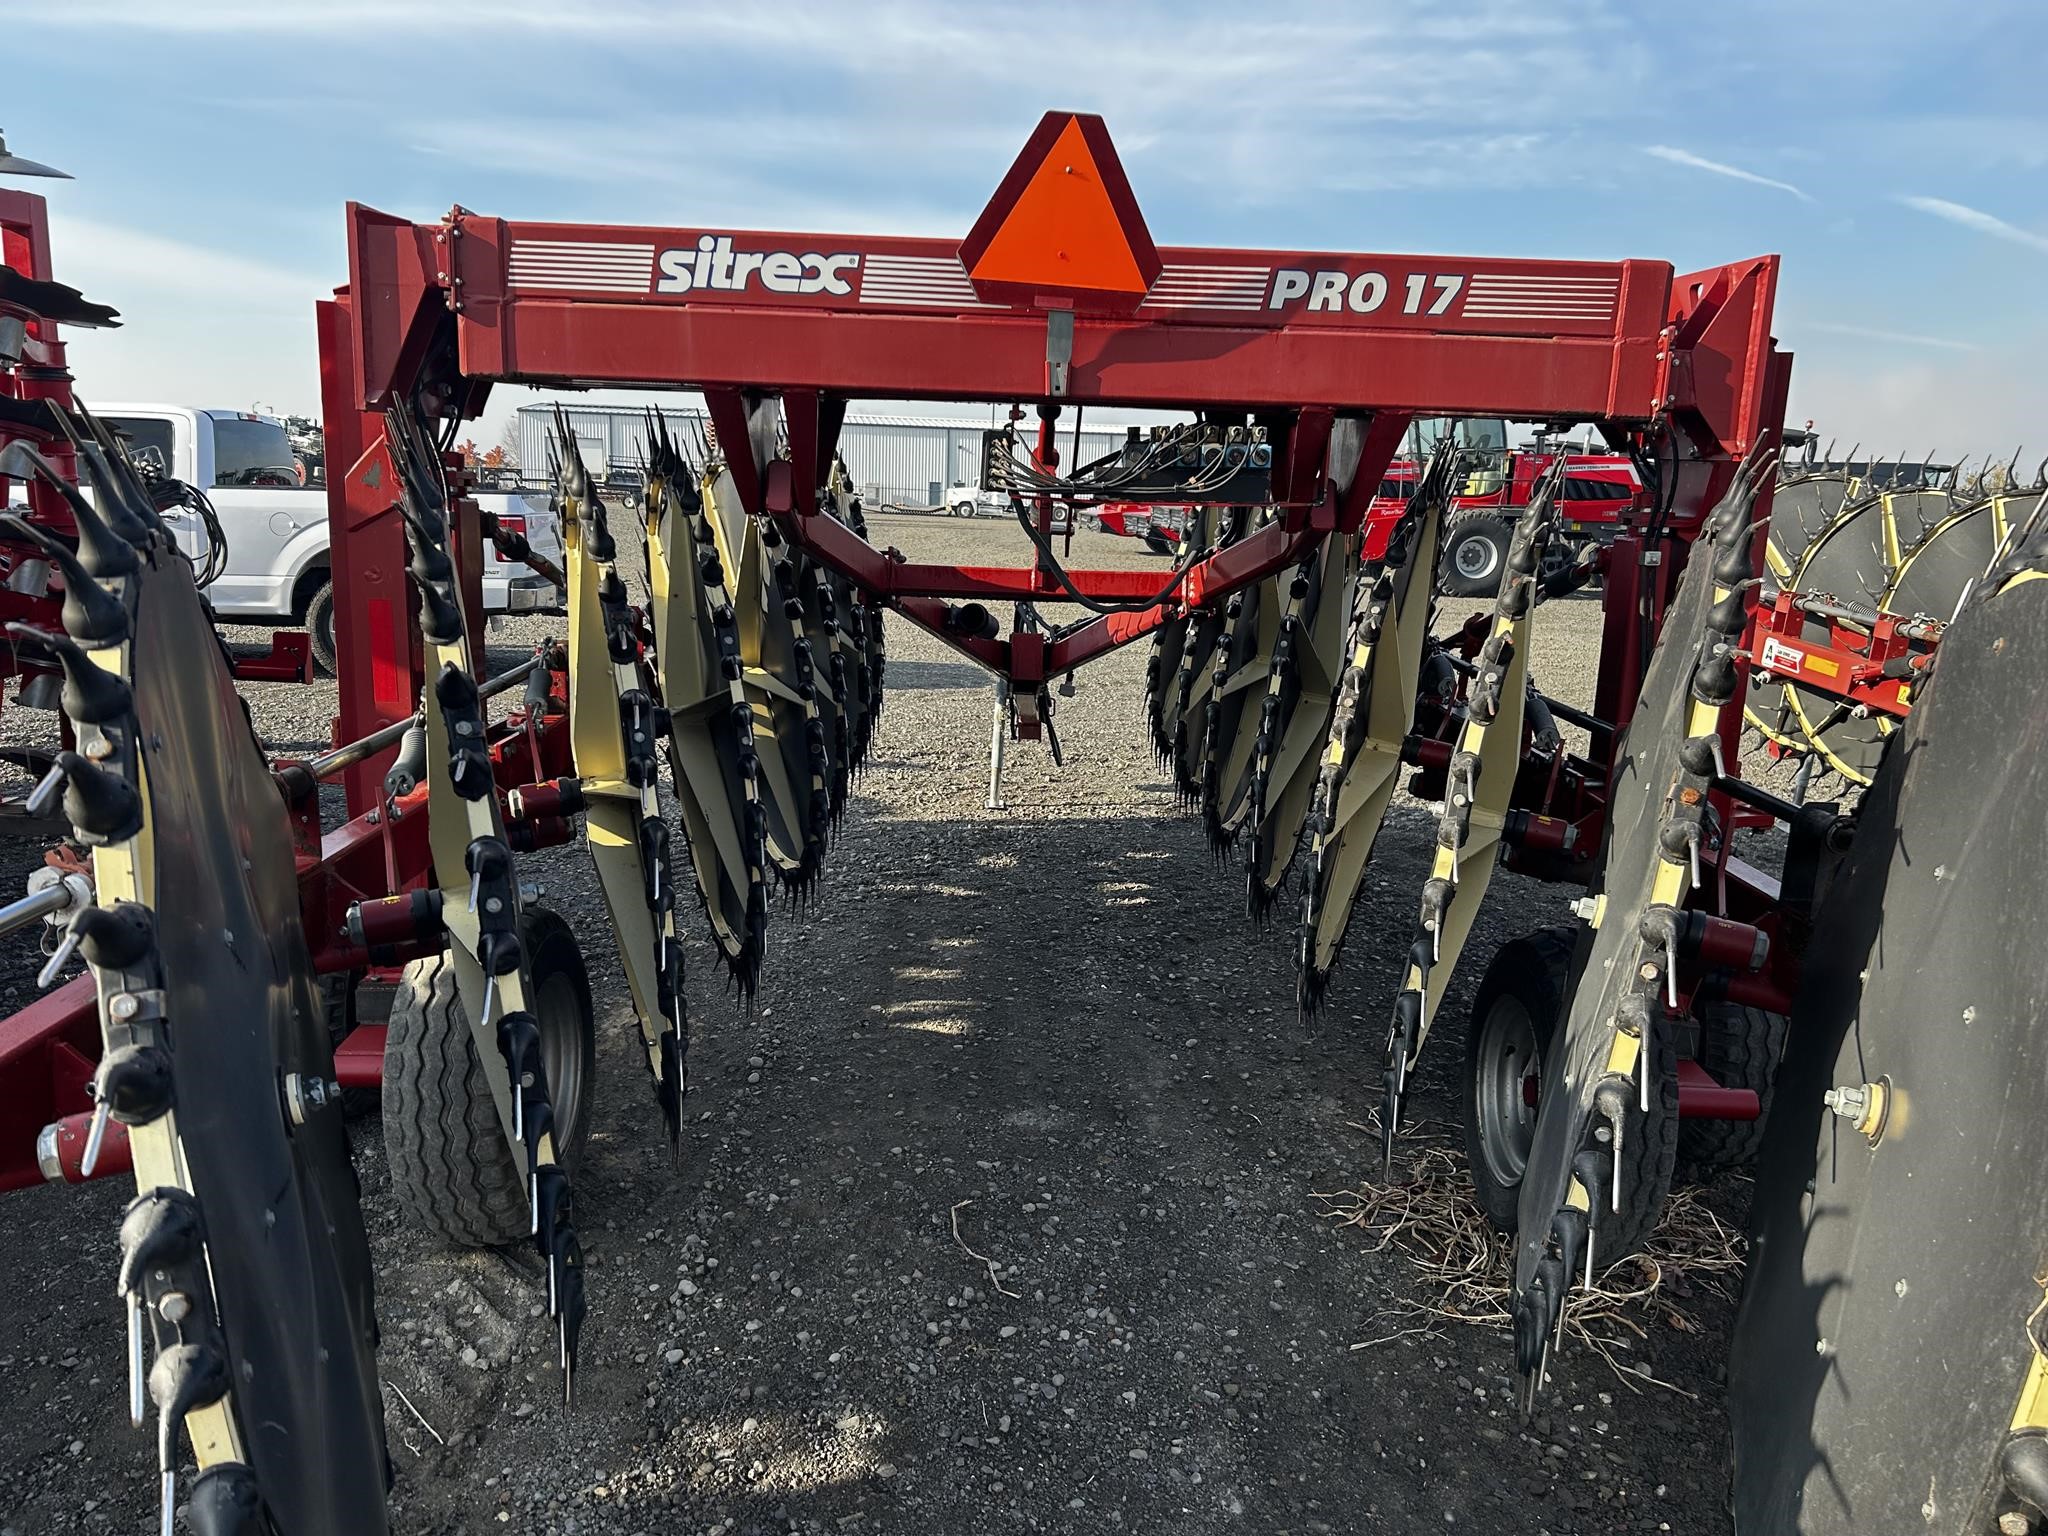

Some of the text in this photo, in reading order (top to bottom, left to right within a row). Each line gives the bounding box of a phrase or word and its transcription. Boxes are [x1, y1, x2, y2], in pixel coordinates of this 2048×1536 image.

[656, 235, 860, 295] sitrex
[1269, 270, 1464, 315] PRO 17
